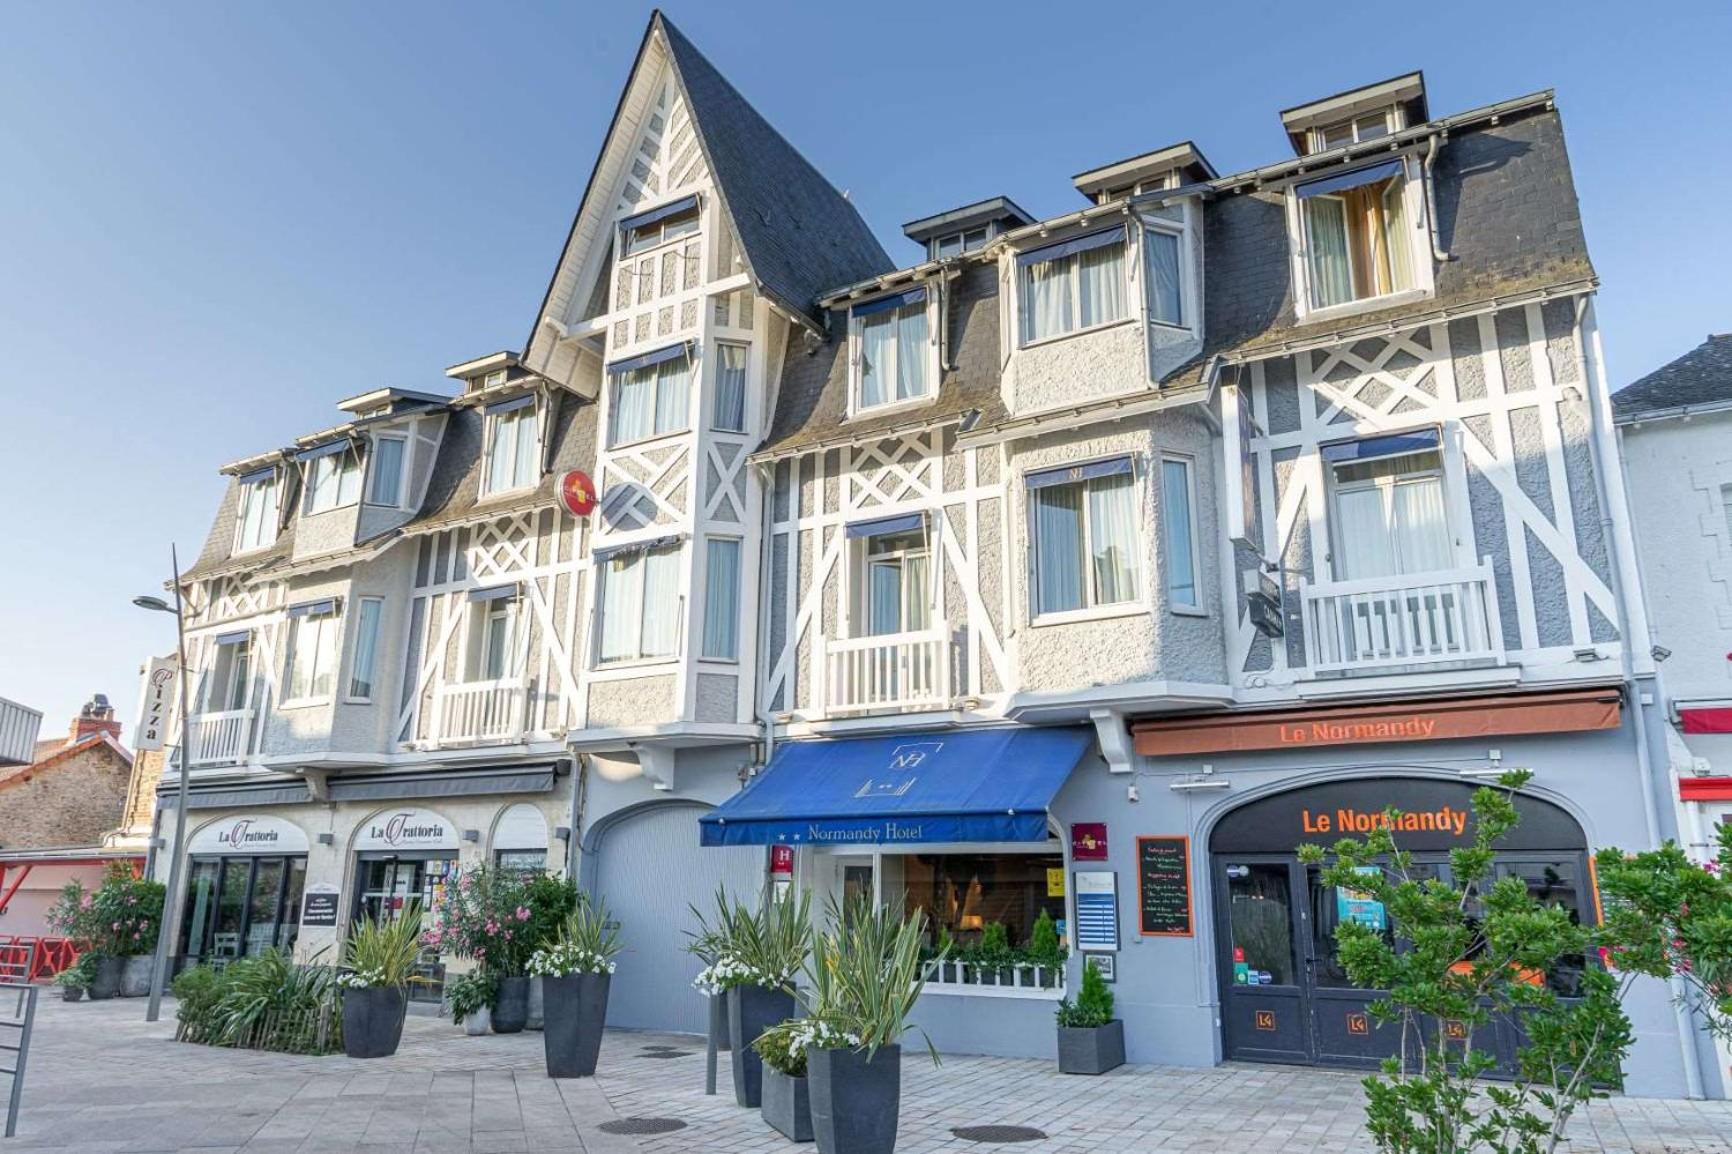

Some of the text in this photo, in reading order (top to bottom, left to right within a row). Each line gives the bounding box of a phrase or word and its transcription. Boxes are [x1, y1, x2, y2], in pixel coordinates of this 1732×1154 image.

[146, 668, 173, 740] Pizza
[1279, 716, 1435, 743] Le Normandy
[1302, 808, 1331, 833] Le
[219, 831, 230, 842] La
[371, 826, 384, 839] La
[808, 822, 922, 841] Normandy Hotel
[780, 849, 790, 861] H
